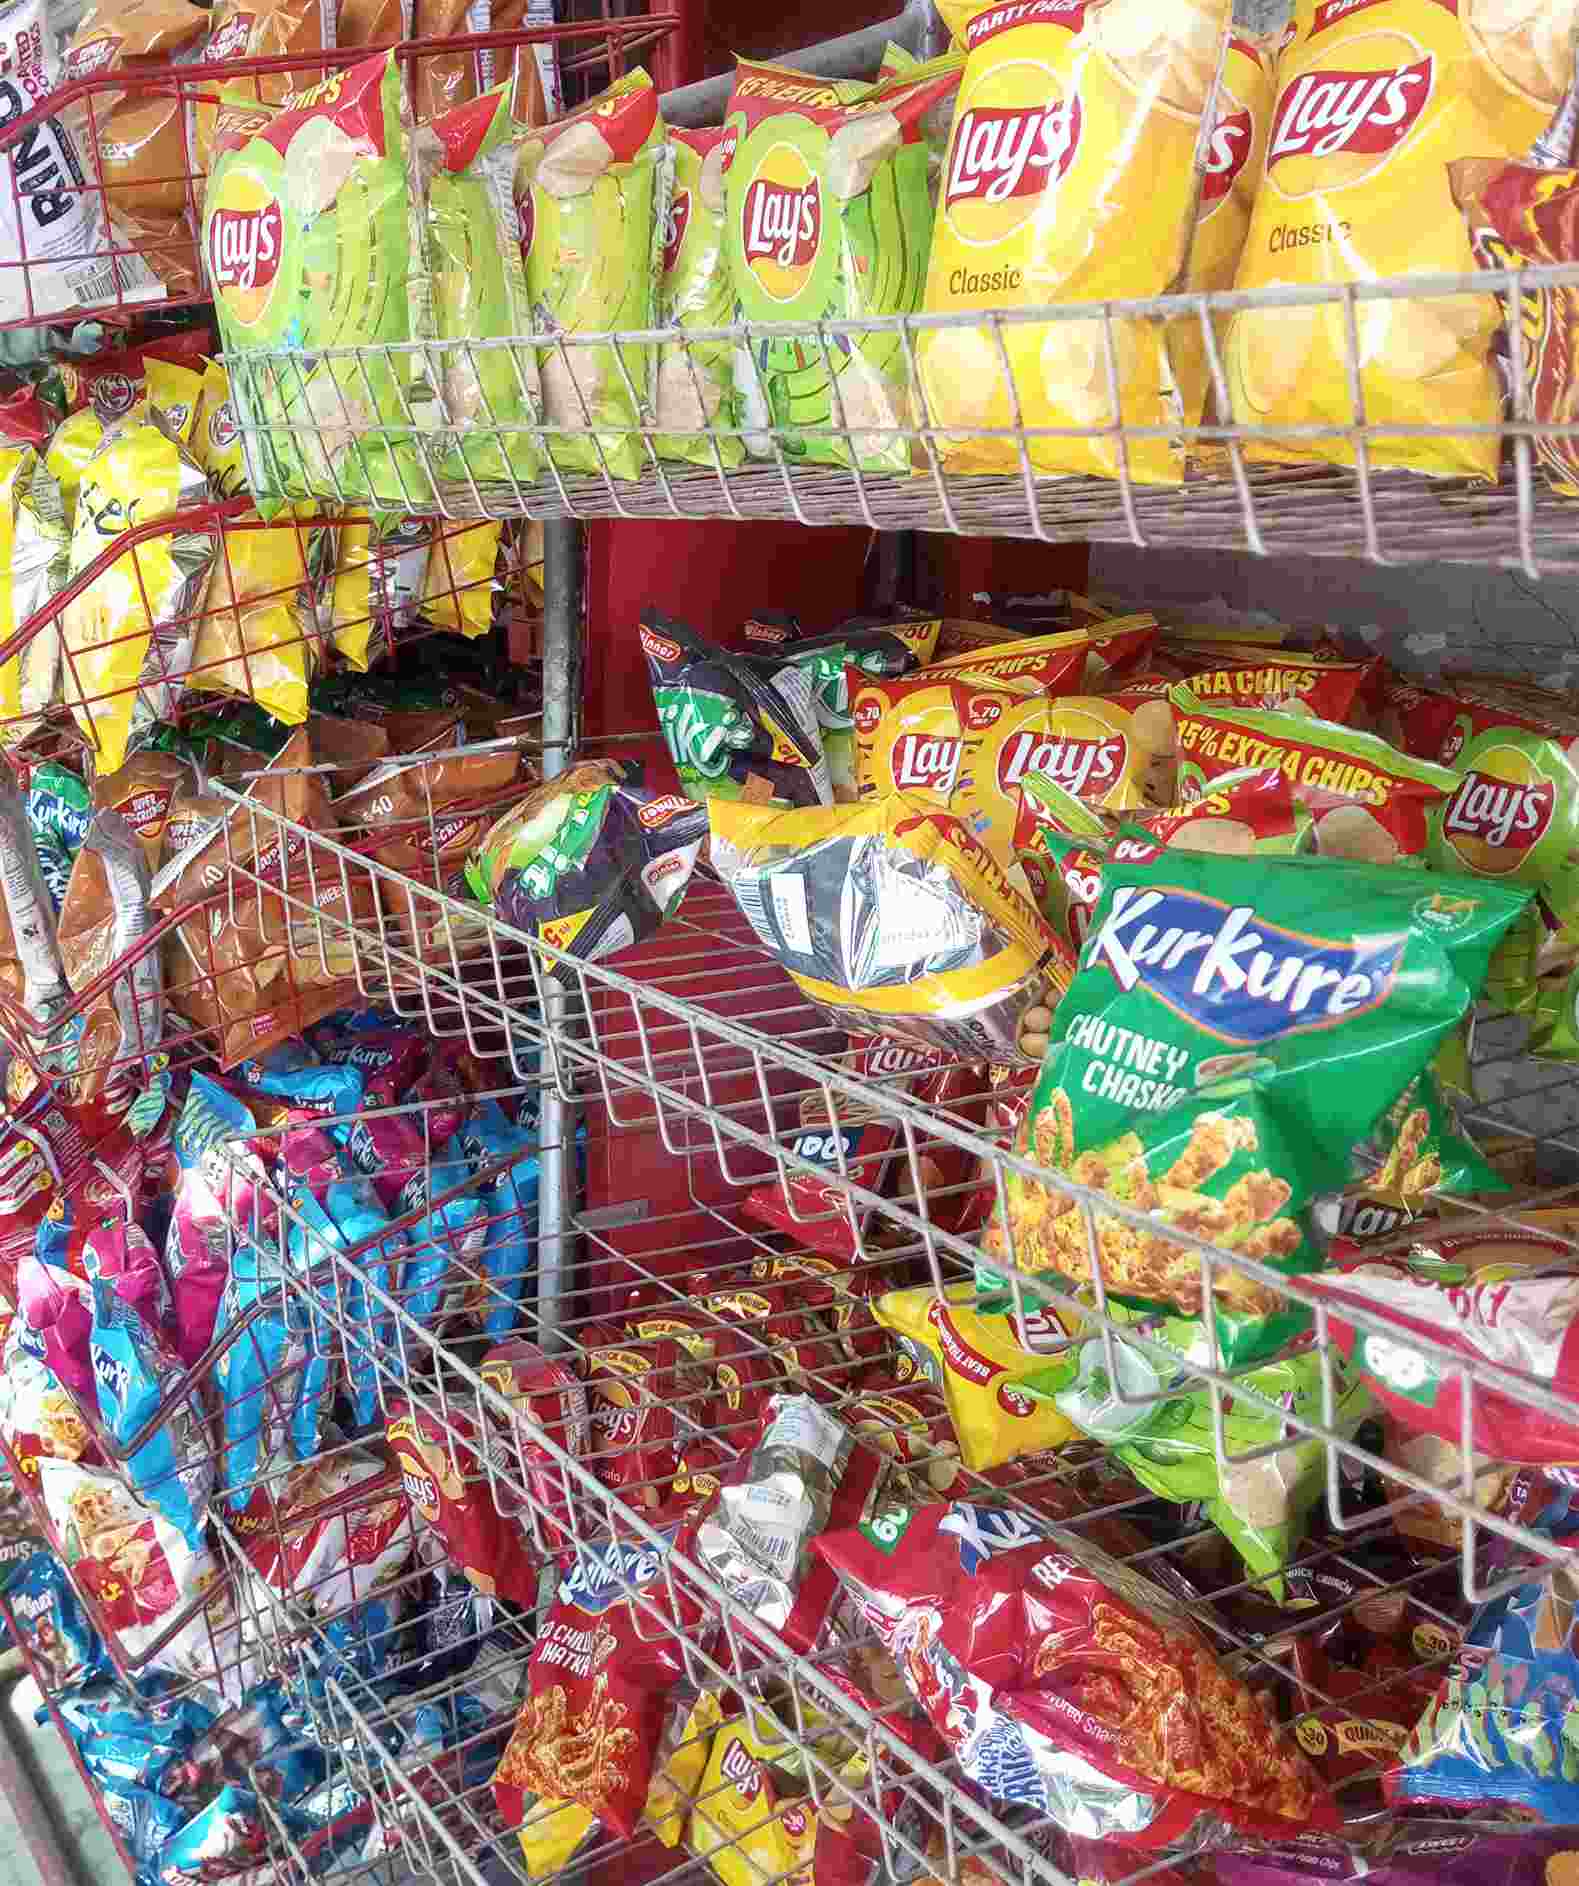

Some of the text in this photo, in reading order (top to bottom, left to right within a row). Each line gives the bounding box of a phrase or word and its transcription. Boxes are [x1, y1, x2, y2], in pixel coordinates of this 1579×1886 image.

[968, 3, 1031, 40] PARTY
[1273, 70, 1425, 157] Lay's
[947, 98, 1074, 202] Lay's
[211, 210, 278, 289] Lay's
[750, 187, 816, 266] Lay's
[949, 264, 1022, 296] Classic
[980, 654, 1049, 676] CHIPS
[1235, 669, 1317, 695] CHIPS
[1005, 733, 1121, 797] Lay's
[1177, 720, 1392, 806] 15% EXTRA CHIPS
[30, 790, 88, 838] Kurkure
[1448, 770, 1549, 848] Lay's
[1086, 886, 1373, 1014] Kurkure
[1066, 1013, 1189, 1080] CHUTNEY
